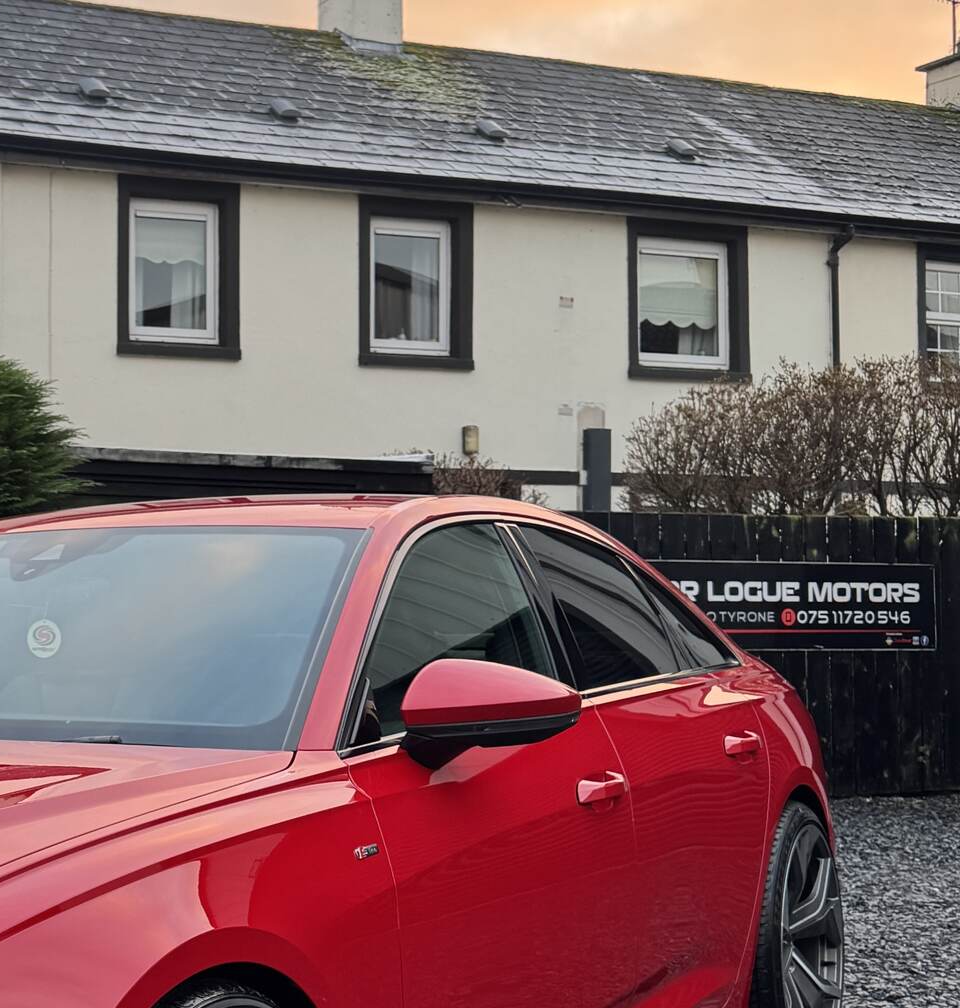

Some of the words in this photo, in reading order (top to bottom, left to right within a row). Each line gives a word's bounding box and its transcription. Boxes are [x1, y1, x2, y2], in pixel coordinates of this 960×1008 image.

[707, 581, 800, 602] LOGUE
[808, 582, 921, 603] MOTORS
[719, 611, 775, 623] TYRONE
